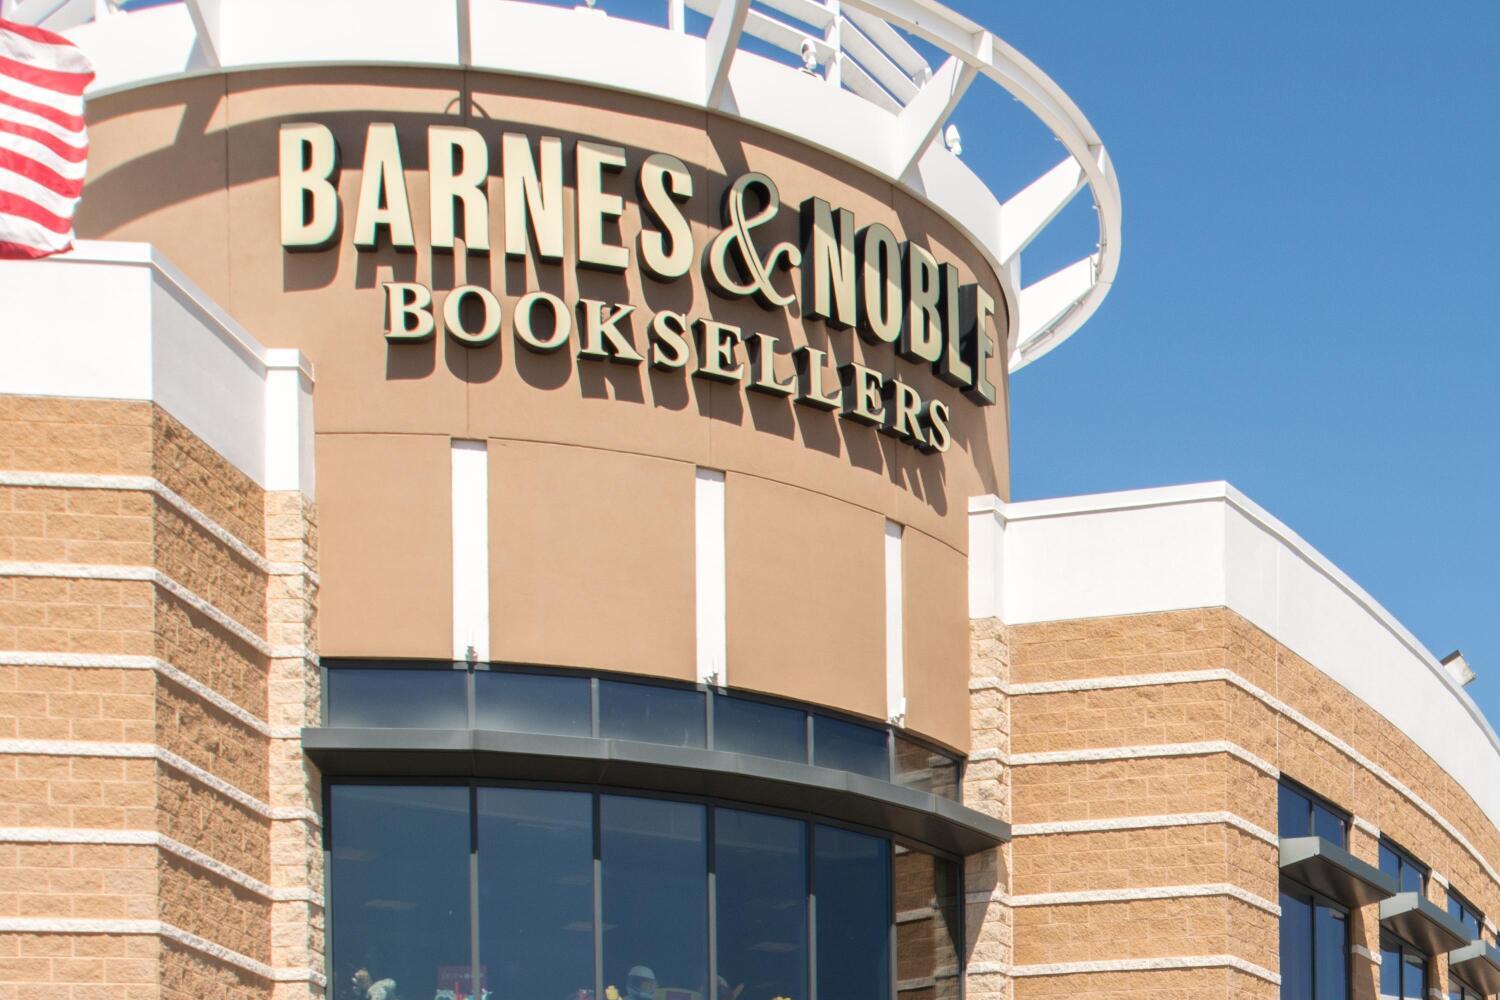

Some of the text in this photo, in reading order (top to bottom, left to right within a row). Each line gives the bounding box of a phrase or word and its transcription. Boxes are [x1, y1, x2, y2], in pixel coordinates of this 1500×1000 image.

[279, 121, 997, 406] BARNES & NOBLE
[383, 280, 951, 454] BOOKSELLERS
